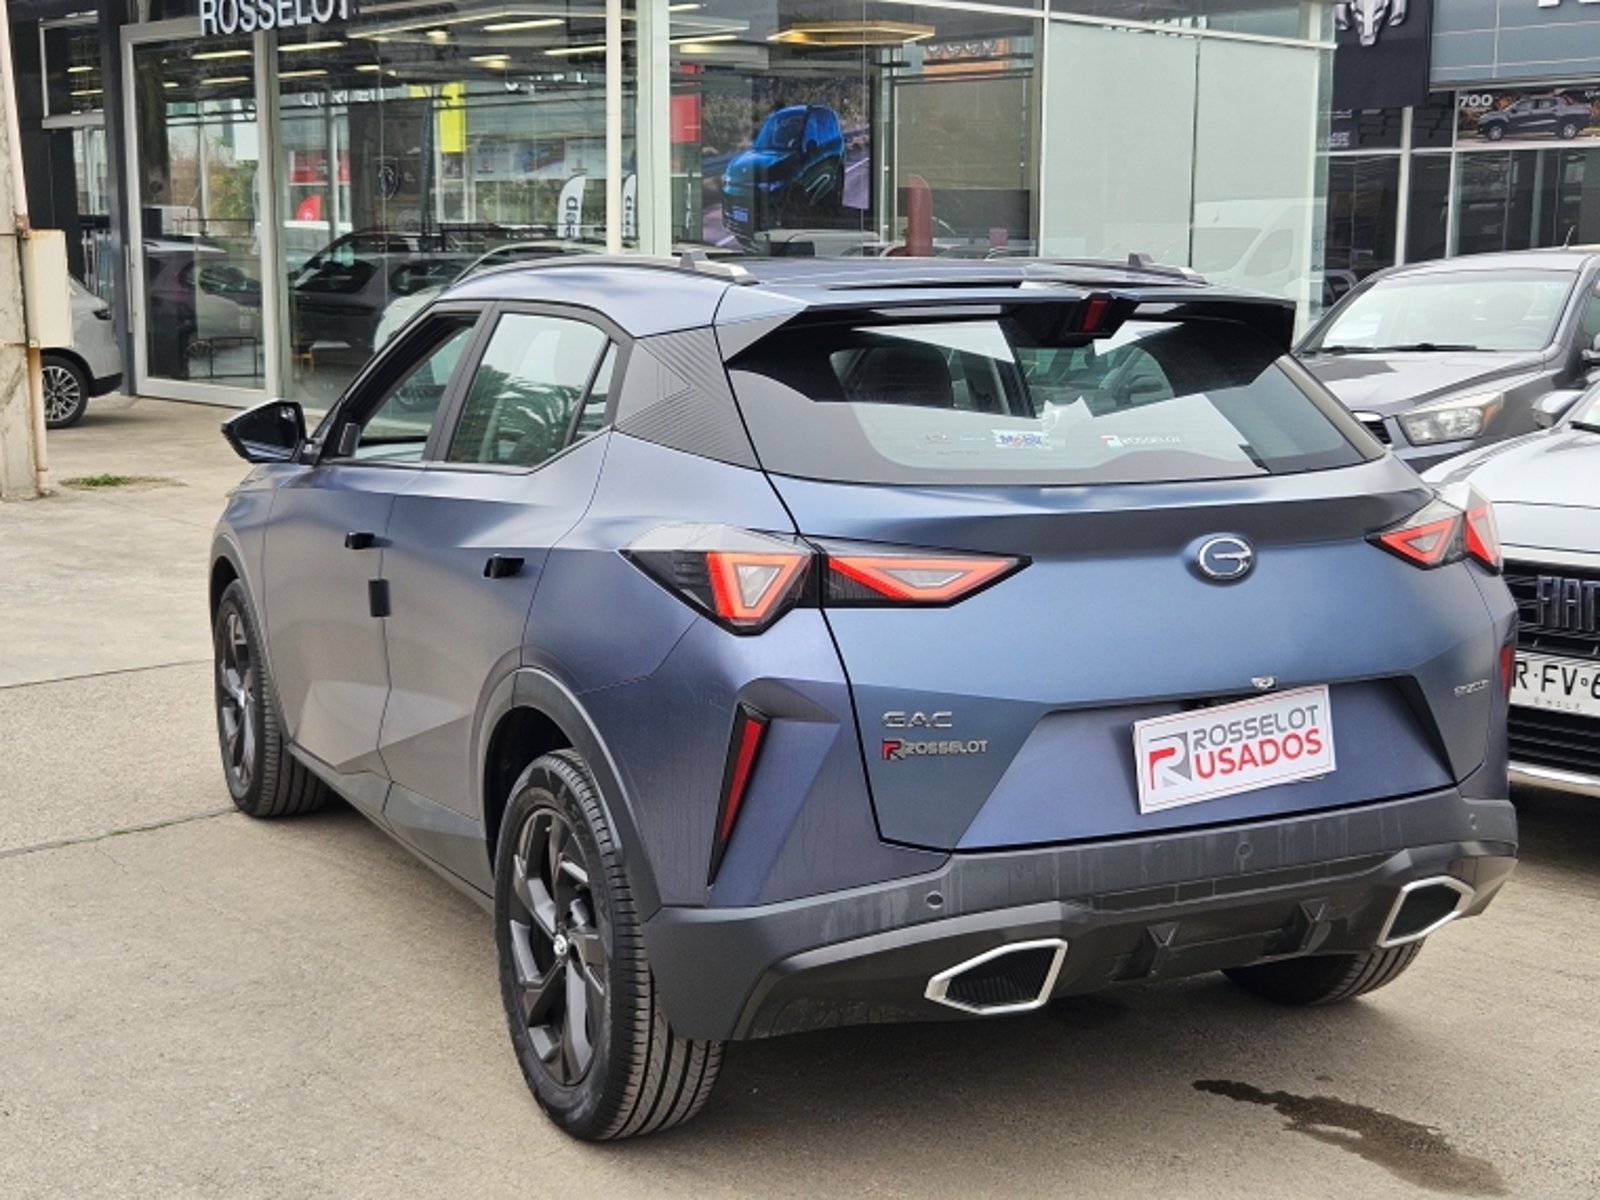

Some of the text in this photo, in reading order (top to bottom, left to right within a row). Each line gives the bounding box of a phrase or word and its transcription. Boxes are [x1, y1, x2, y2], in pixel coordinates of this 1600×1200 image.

[1460, 94, 1494, 107] 700
[1536, 575, 1600, 631] FIAT
[882, 711, 953, 728] GAC
[1193, 705, 1319, 752] ROSSELOT
[905, 740, 988, 755] ROSSELOT
[1194, 728, 1323, 780] USADOS
